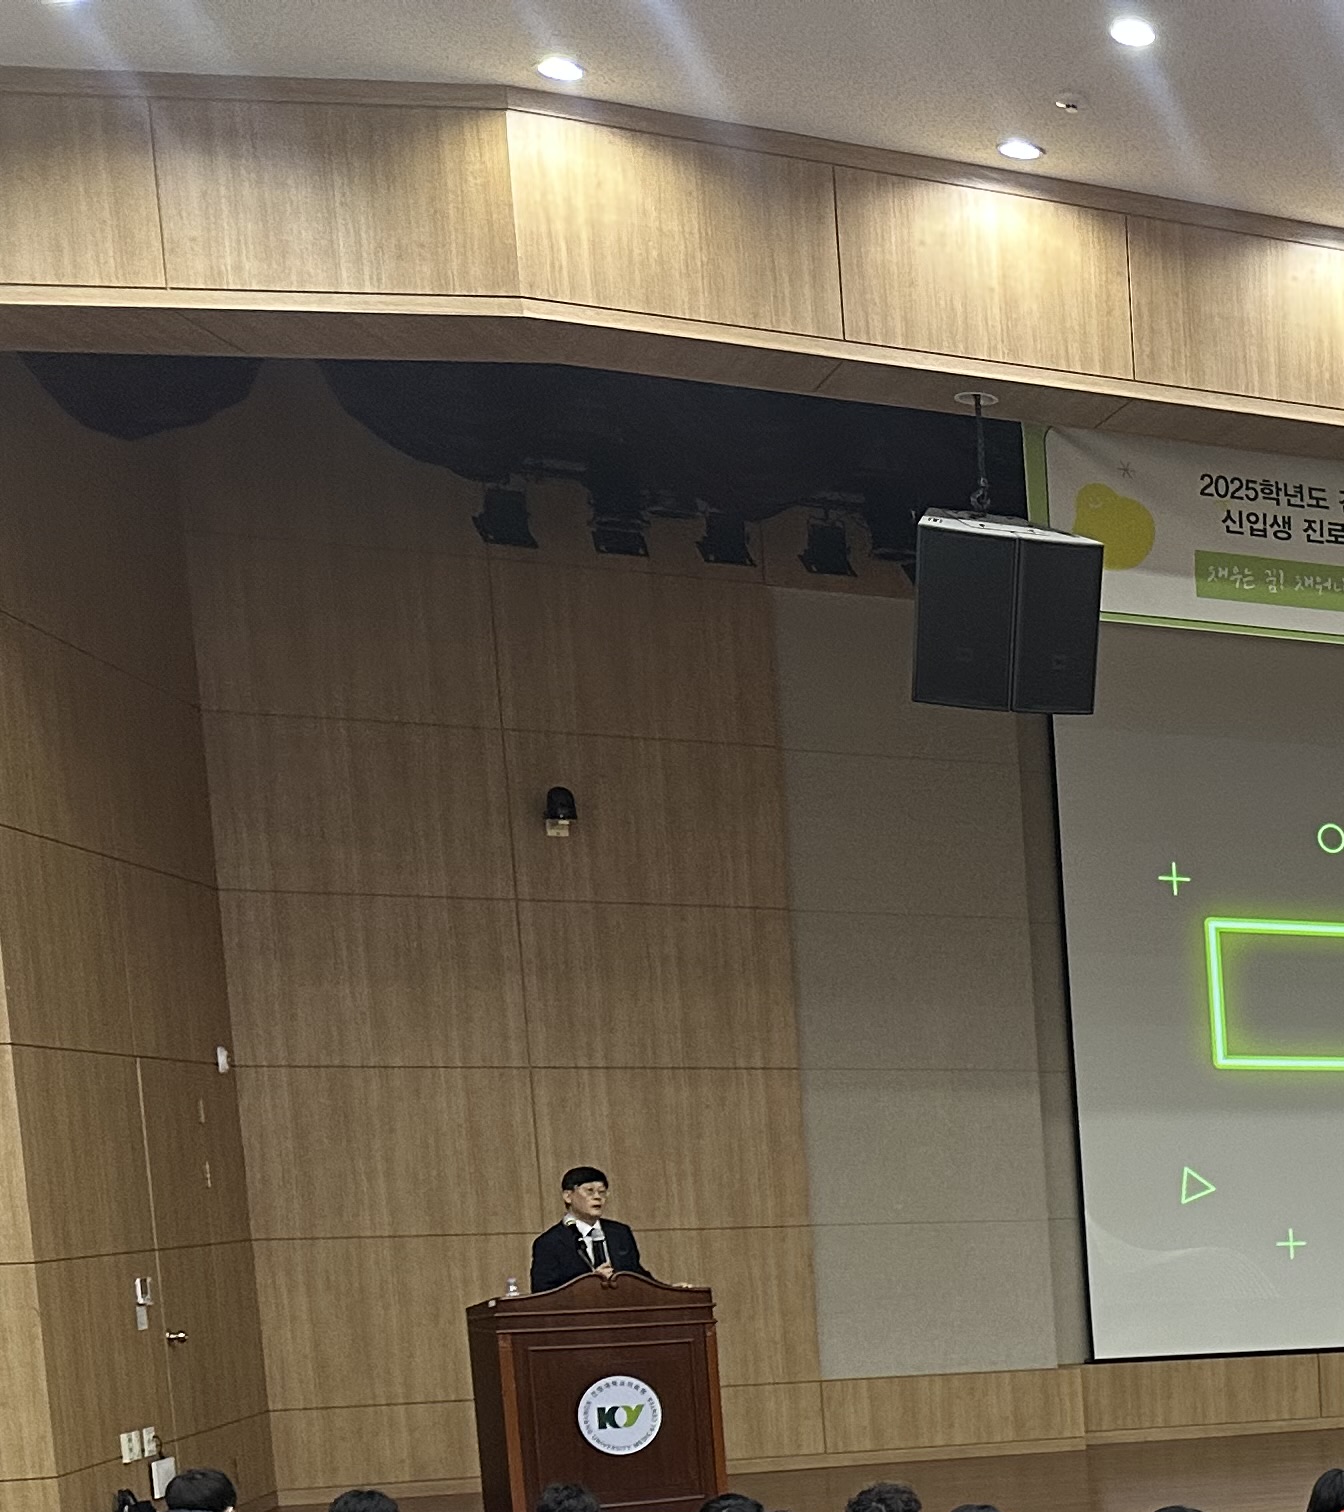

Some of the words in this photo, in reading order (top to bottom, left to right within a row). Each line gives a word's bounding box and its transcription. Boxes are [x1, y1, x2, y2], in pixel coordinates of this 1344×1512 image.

[1199, 473, 1330, 511] 2025학년도
[1221, 509, 1293, 541] 신입생
[1207, 564, 1256, 590] 채우는
